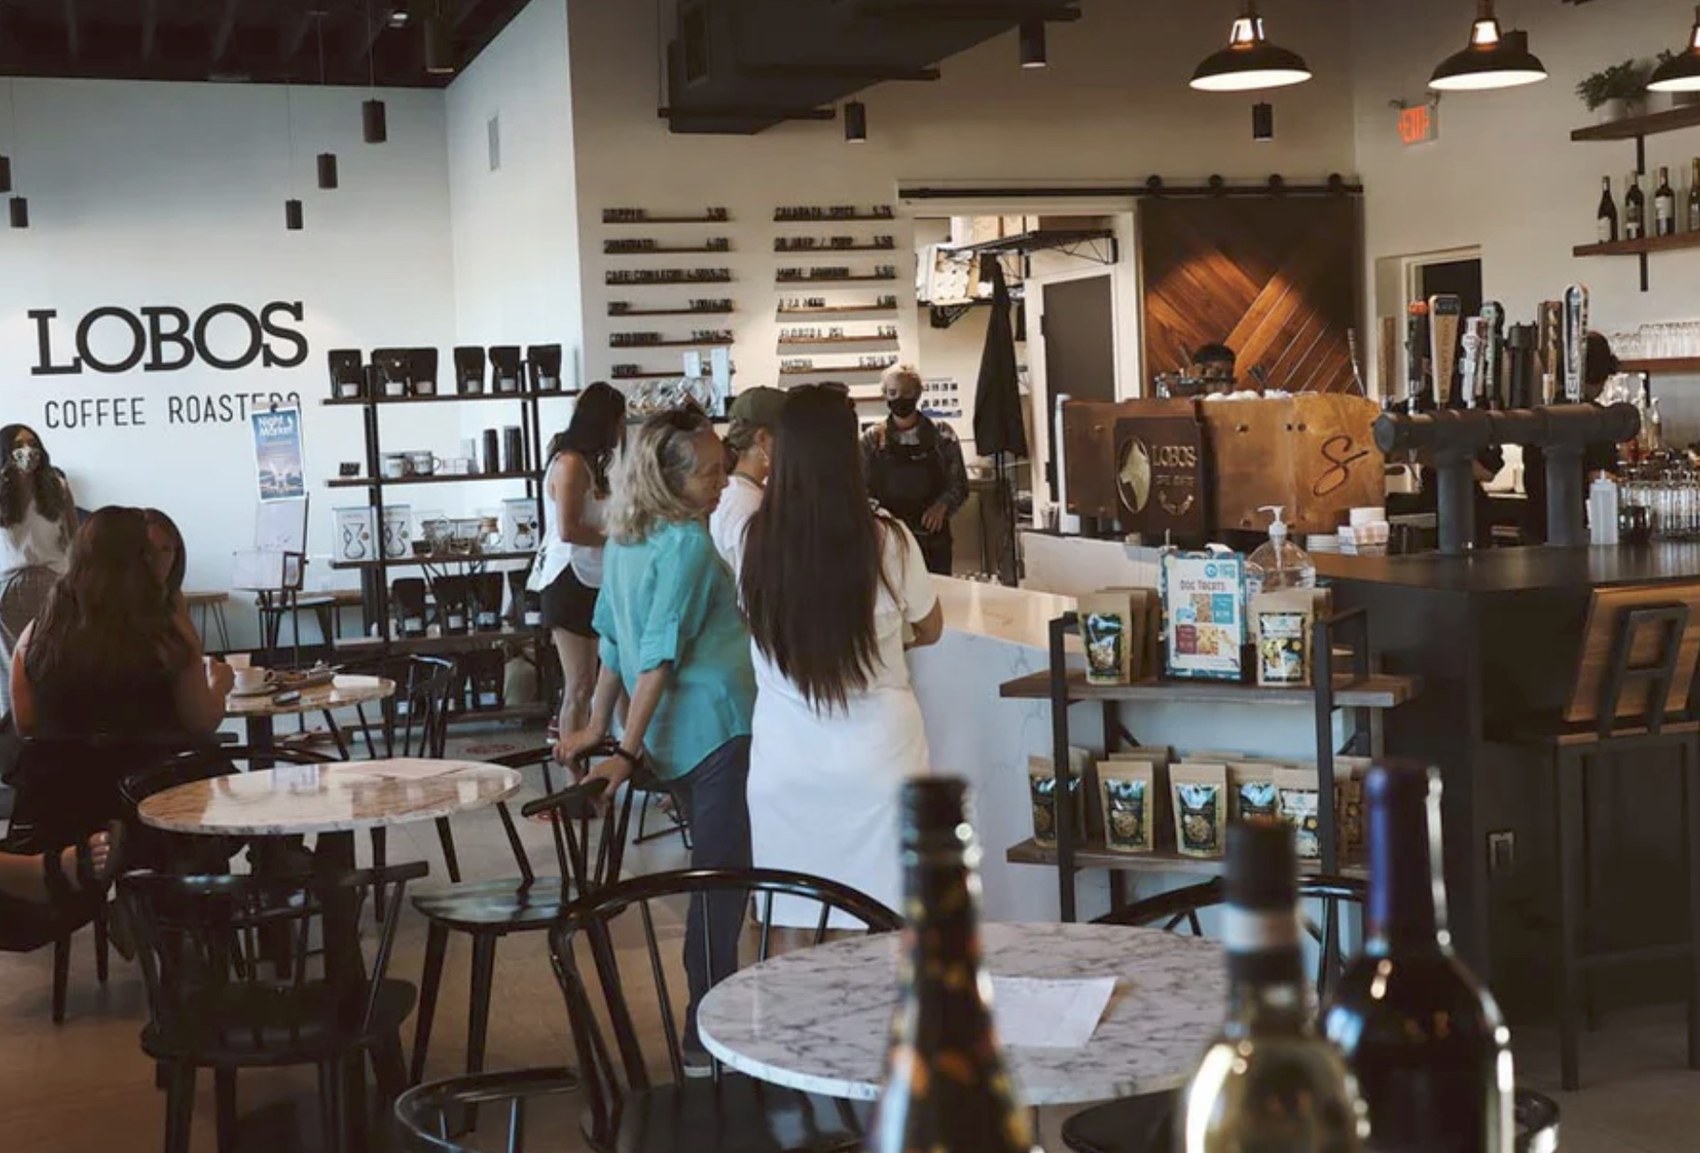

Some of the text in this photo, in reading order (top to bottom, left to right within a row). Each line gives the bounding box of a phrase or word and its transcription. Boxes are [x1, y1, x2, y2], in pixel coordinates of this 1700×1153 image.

[27, 301, 309, 376] LOBOS
[44, 397, 147, 428] COFFEE
[1151, 444, 1197, 468] LOBOS
